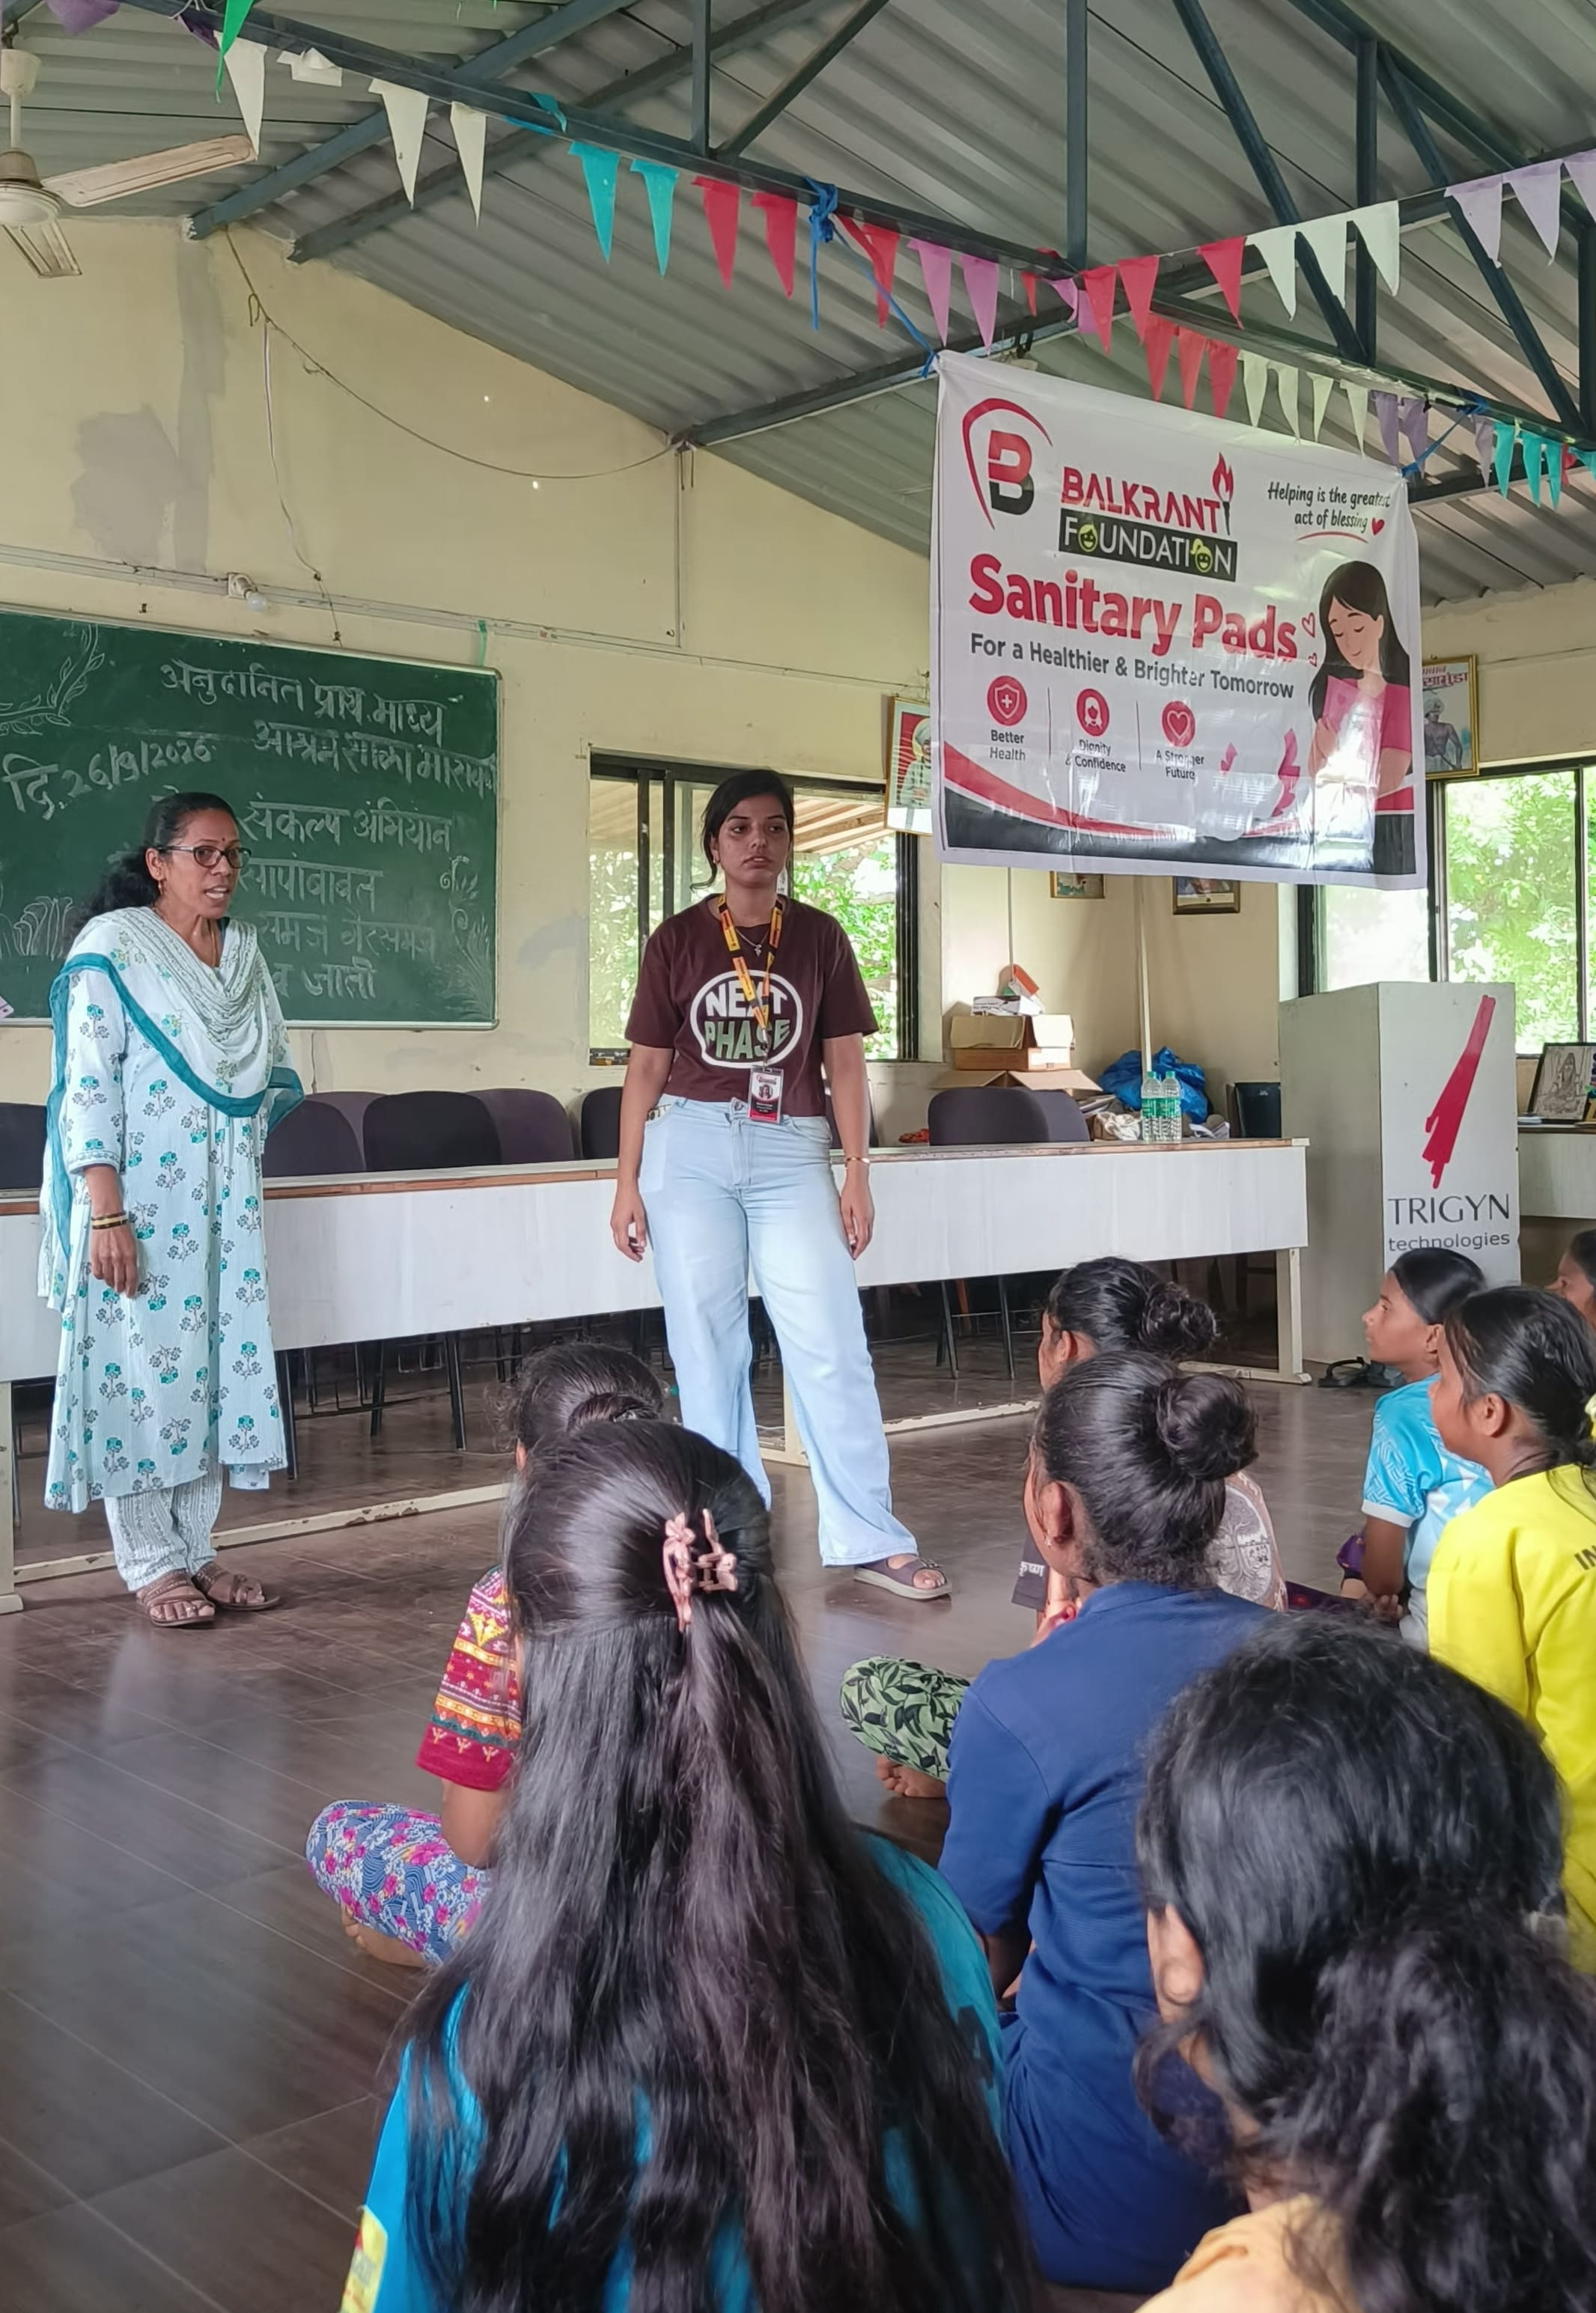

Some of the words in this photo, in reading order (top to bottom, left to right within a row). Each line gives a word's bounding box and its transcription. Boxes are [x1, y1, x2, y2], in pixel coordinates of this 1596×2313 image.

[1267, 481, 1313, 507] Helping
[1317, 487, 1326, 502] is
[1329, 487, 1347, 504] the
[1294, 510, 1313, 525] act
[1316, 509, 1329, 529] of
[1330, 509, 1368, 534] blessing
[969, 553, 1182, 656] Sanitary
[1193, 594, 1298, 662] Pads
[971, 633, 1005, 657] For
[1012, 642, 1023, 659] a
[1030, 641, 1109, 674] Healthier
[1115, 656, 1127, 676] &
[1134, 659, 1204, 687] Brighter
[1210, 669, 1294, 698] Tomorrow
[159, 659, 304, 712] अनुदानित
[990, 729, 1024, 744] Better
[990, 747, 1026, 761] Health
[1075, 755, 1126, 772] Confidence
[1157, 749, 1162, 760] A
[1166, 767, 1196, 780] Future
[1388, 1193, 1510, 1225] TRIGYN
[1389, 1232, 1511, 1252] technologies
